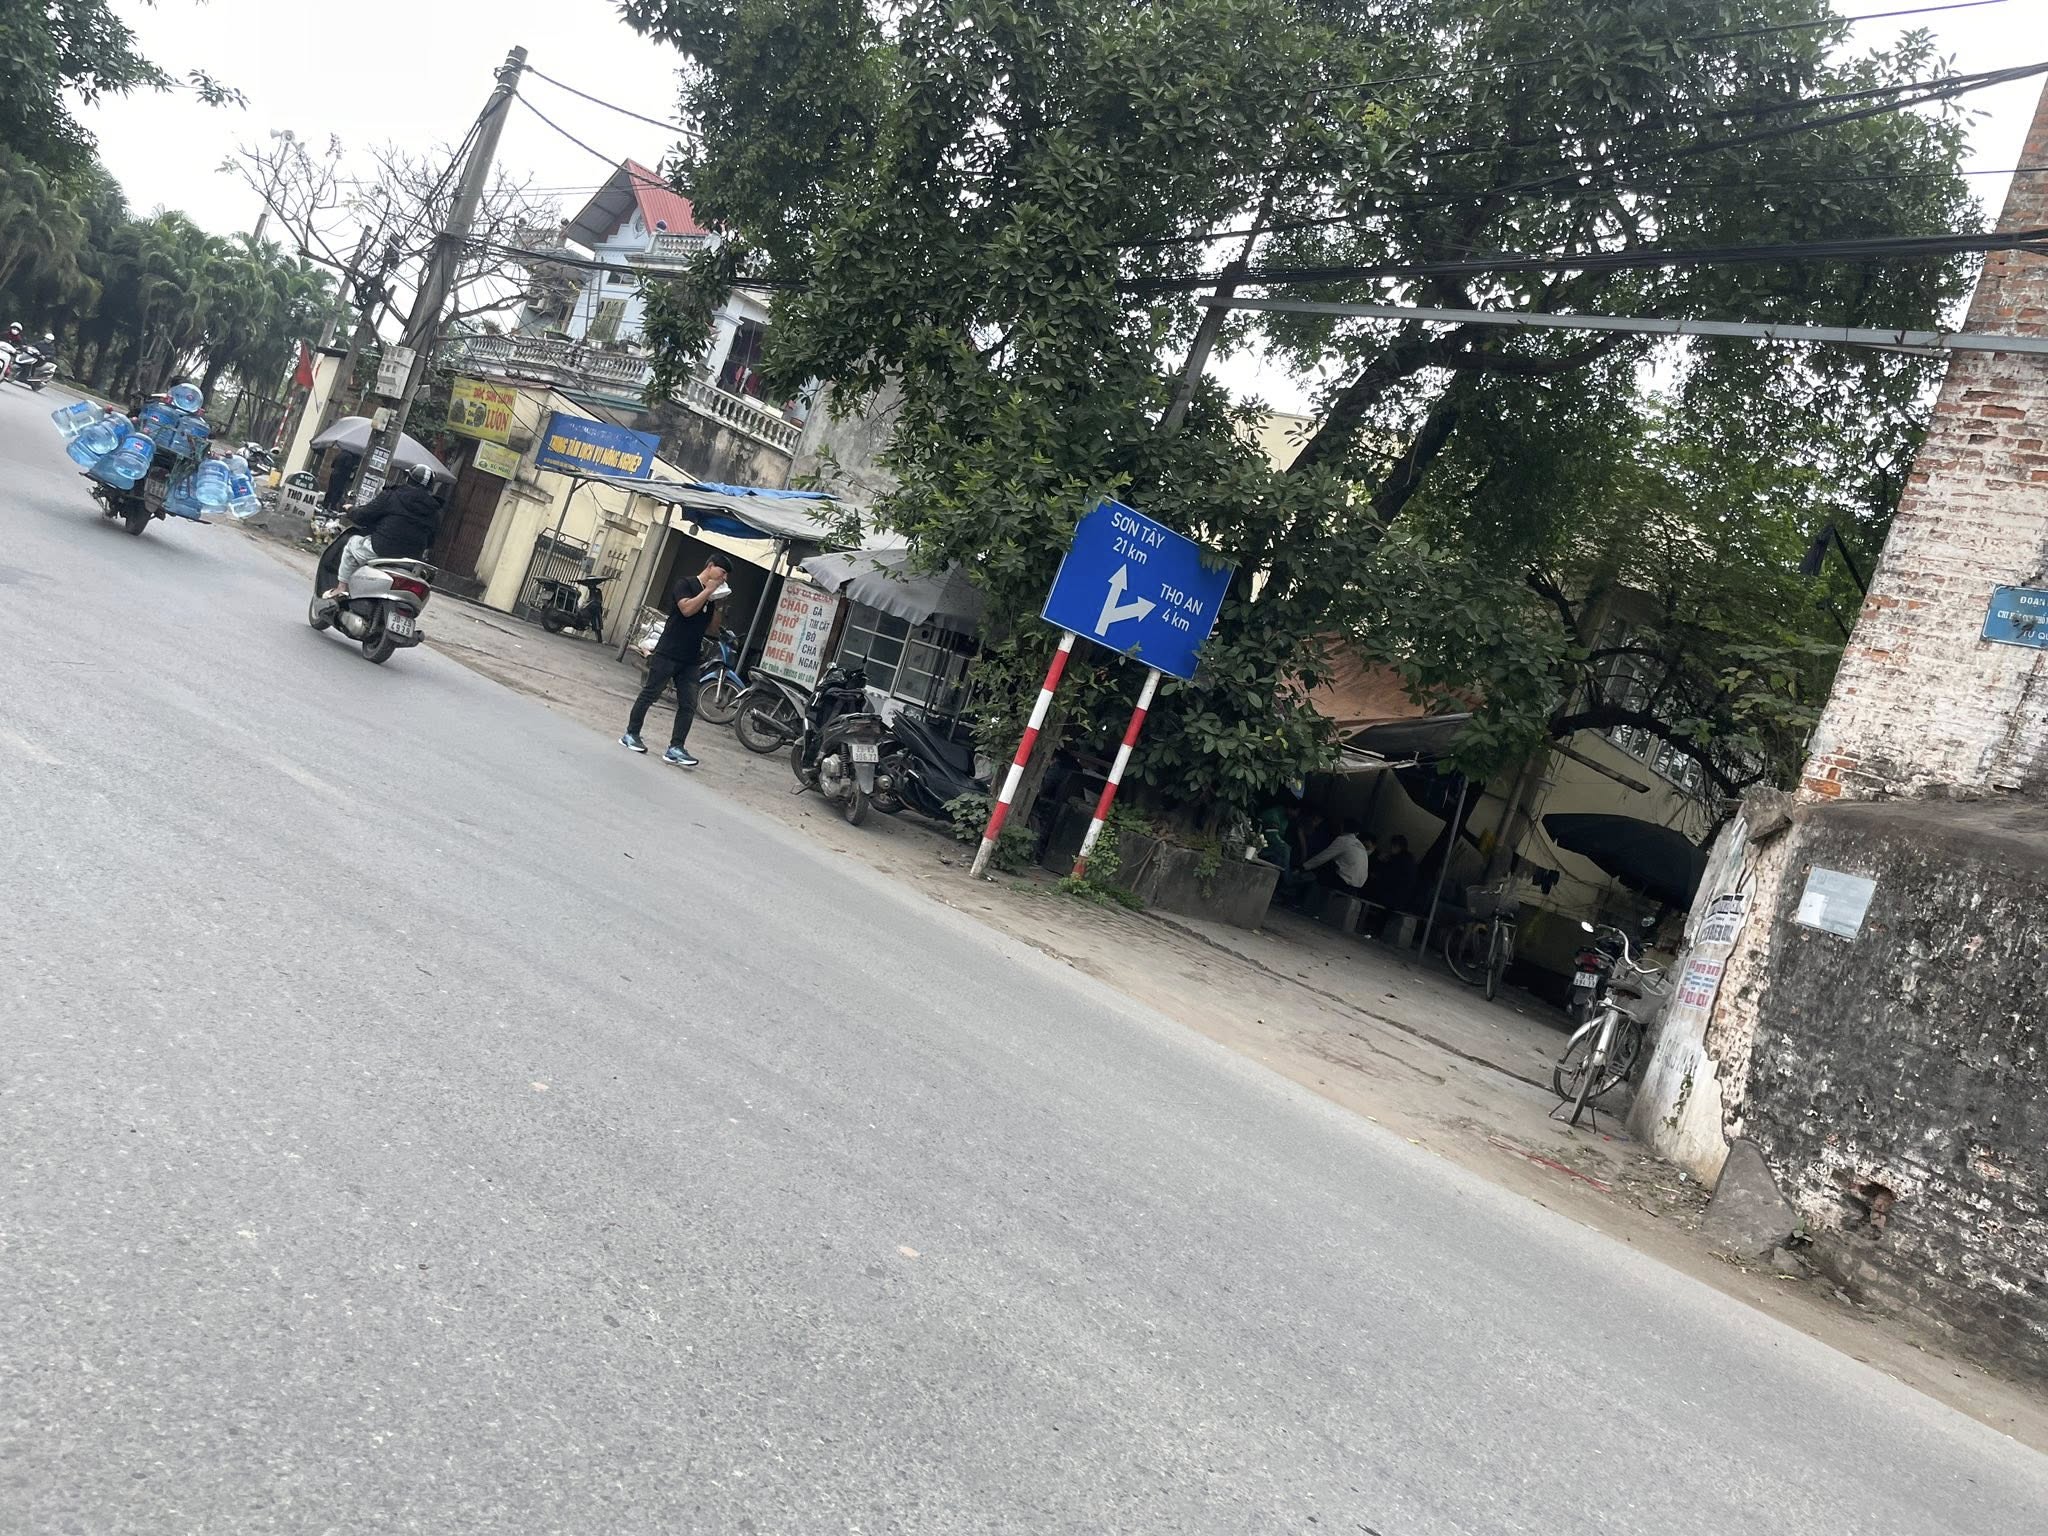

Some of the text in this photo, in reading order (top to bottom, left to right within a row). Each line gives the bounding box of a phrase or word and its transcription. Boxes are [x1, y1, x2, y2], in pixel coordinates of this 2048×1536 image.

[303, 494, 315, 505] AN
[1110, 511, 1166, 549] SƠN TÂY
[1113, 538, 1148, 565] 21 km
[1160, 583, 1203, 616] THỌ AN
[2020, 596, 2045, 607] ĐOẠN
[812, 605, 823, 617] GÀ
[776, 613, 800, 628] PHỞ
[1162, 608, 1190, 632] 4 km
[390, 624, 411, 635] 4939
[798, 657, 819, 671] NGAN
